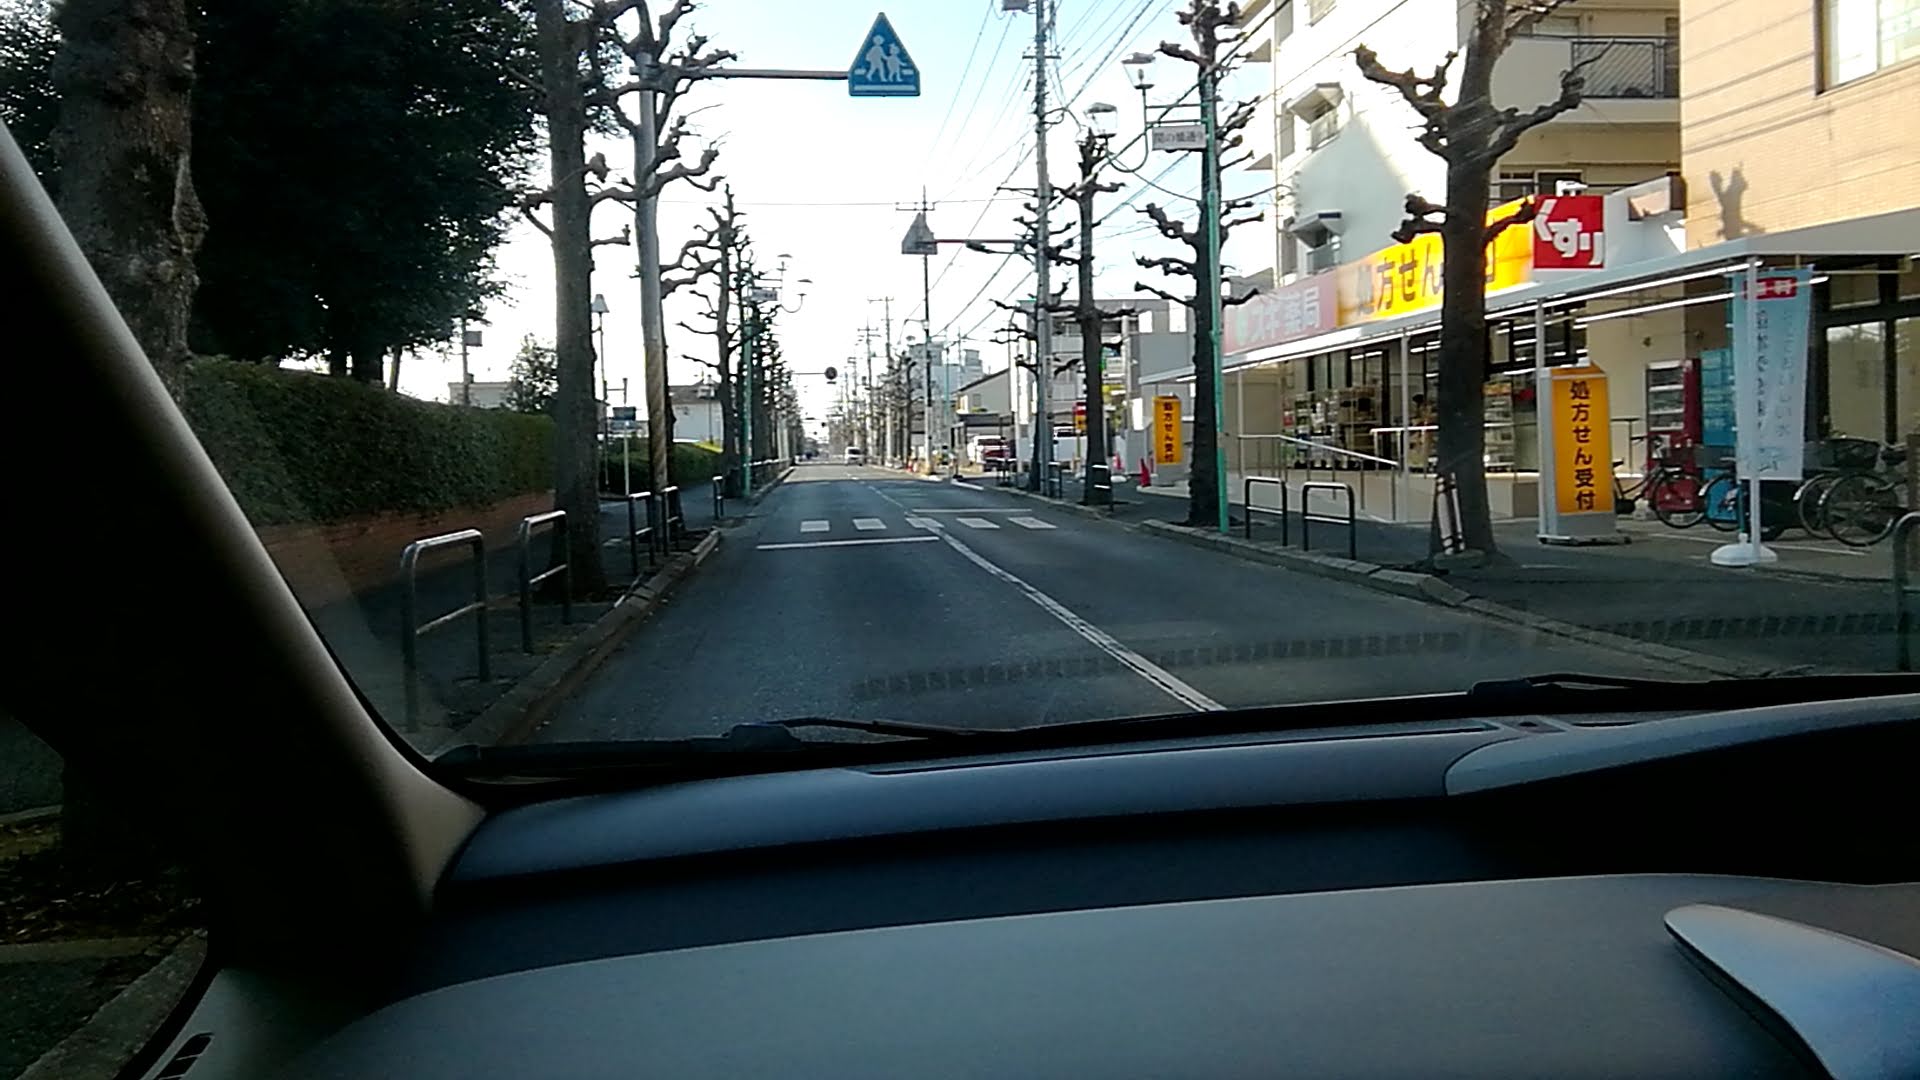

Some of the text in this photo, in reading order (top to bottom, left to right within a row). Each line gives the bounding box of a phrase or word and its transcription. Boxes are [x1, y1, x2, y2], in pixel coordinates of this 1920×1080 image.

[1534, 199, 1604, 266] くすり
[1570, 381, 1596, 510] 処方せん受付
